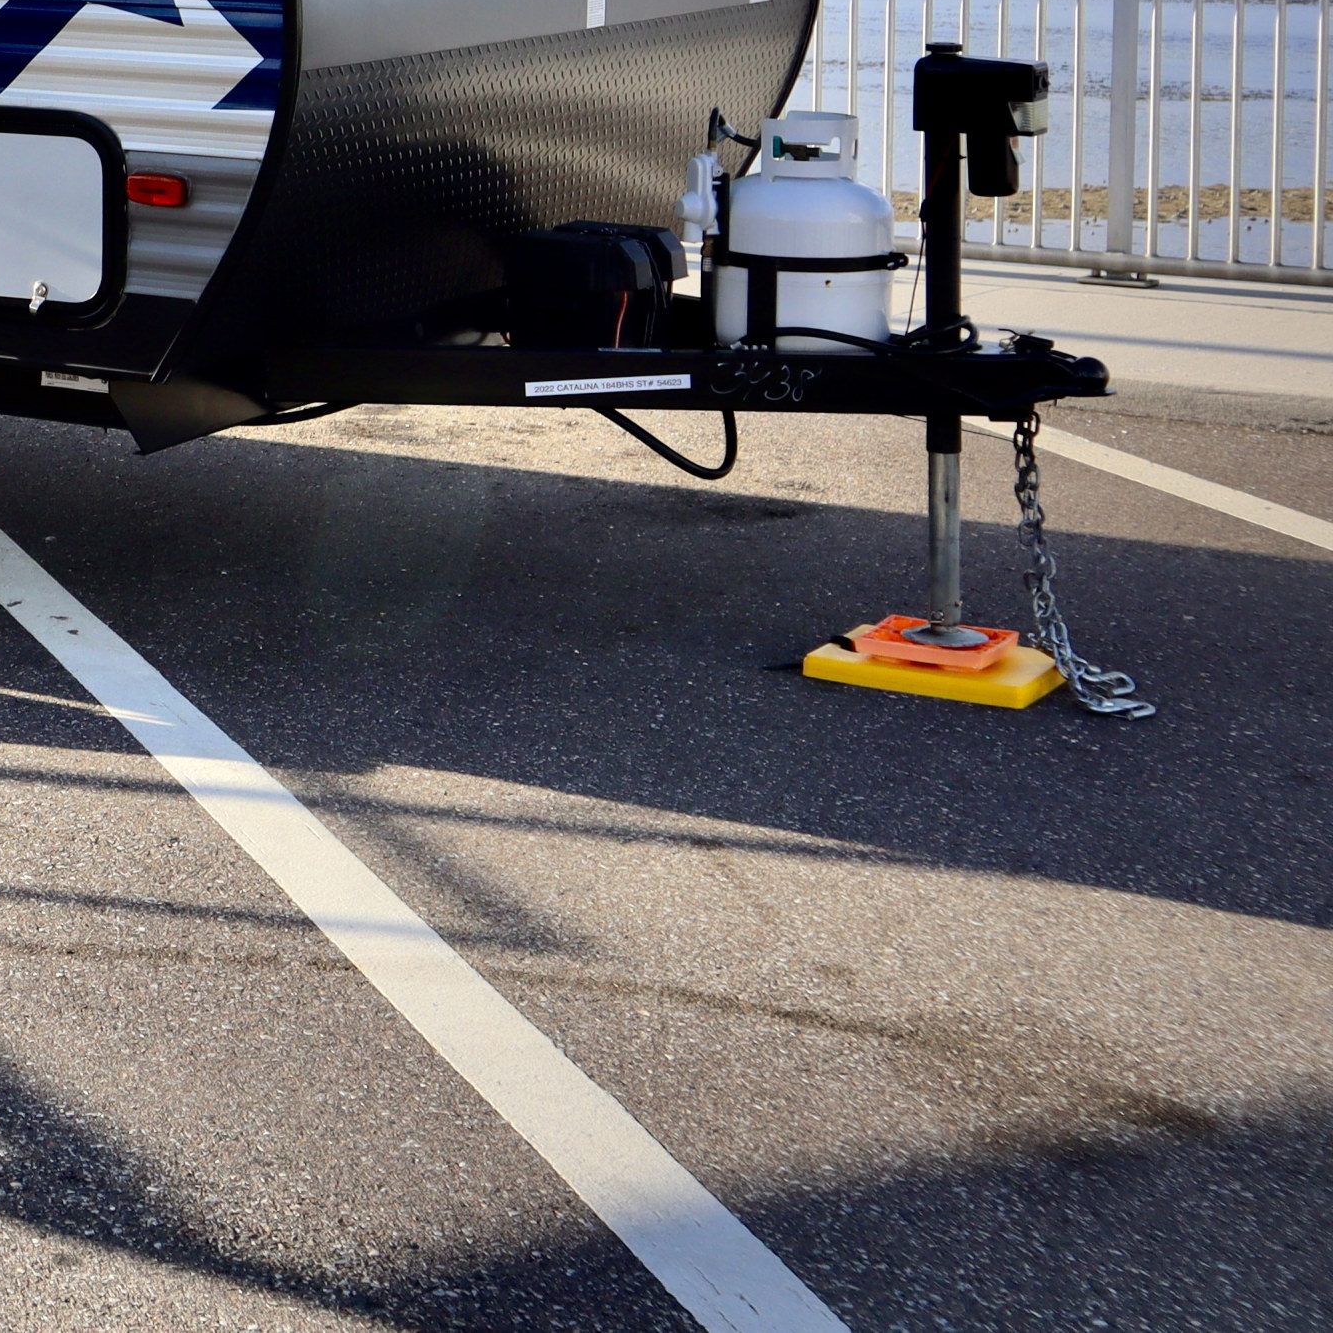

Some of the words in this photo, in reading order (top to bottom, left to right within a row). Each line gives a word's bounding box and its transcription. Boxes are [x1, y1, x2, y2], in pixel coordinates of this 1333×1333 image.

[534, 385, 555, 394] 2022
[557, 382, 599, 392] CATALINA
[601, 380, 634, 390] 184BHS
[636, 379, 654, 388] ST#
[657, 378, 682, 387] 54623
